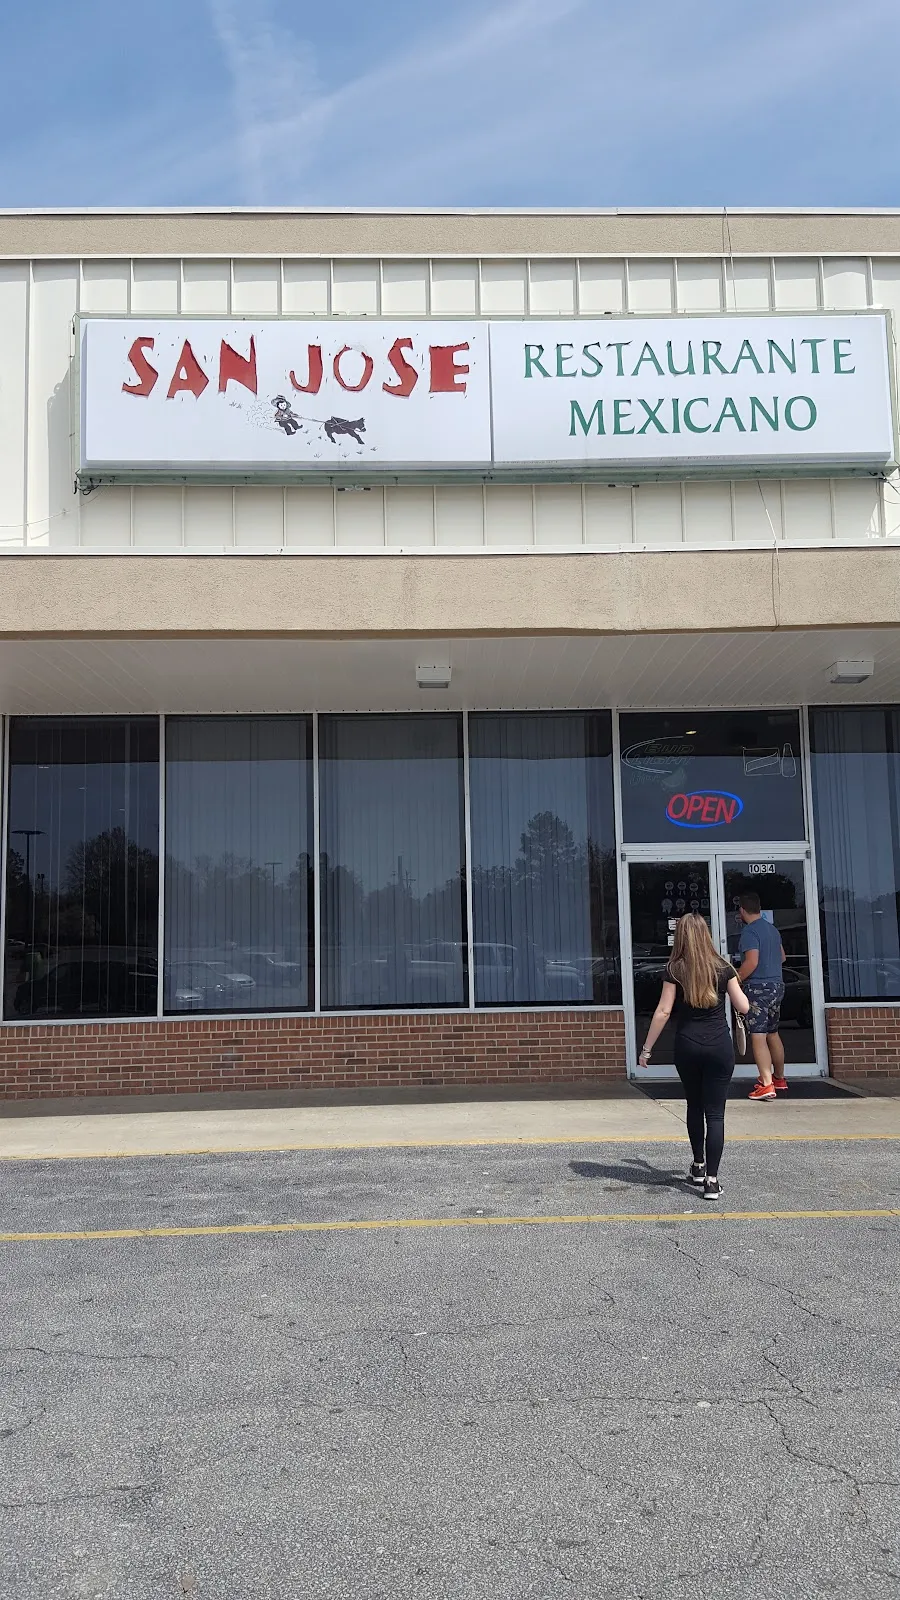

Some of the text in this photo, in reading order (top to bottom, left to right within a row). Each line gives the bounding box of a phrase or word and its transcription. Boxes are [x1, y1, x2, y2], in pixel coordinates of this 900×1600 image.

[121, 334, 470, 399] SAN JOSE
[523, 338, 856, 378] RESTAURANTE
[568, 395, 818, 436] MEXICANO
[667, 793, 736, 824] OPEN
[749, 864, 775, 873] 1034
